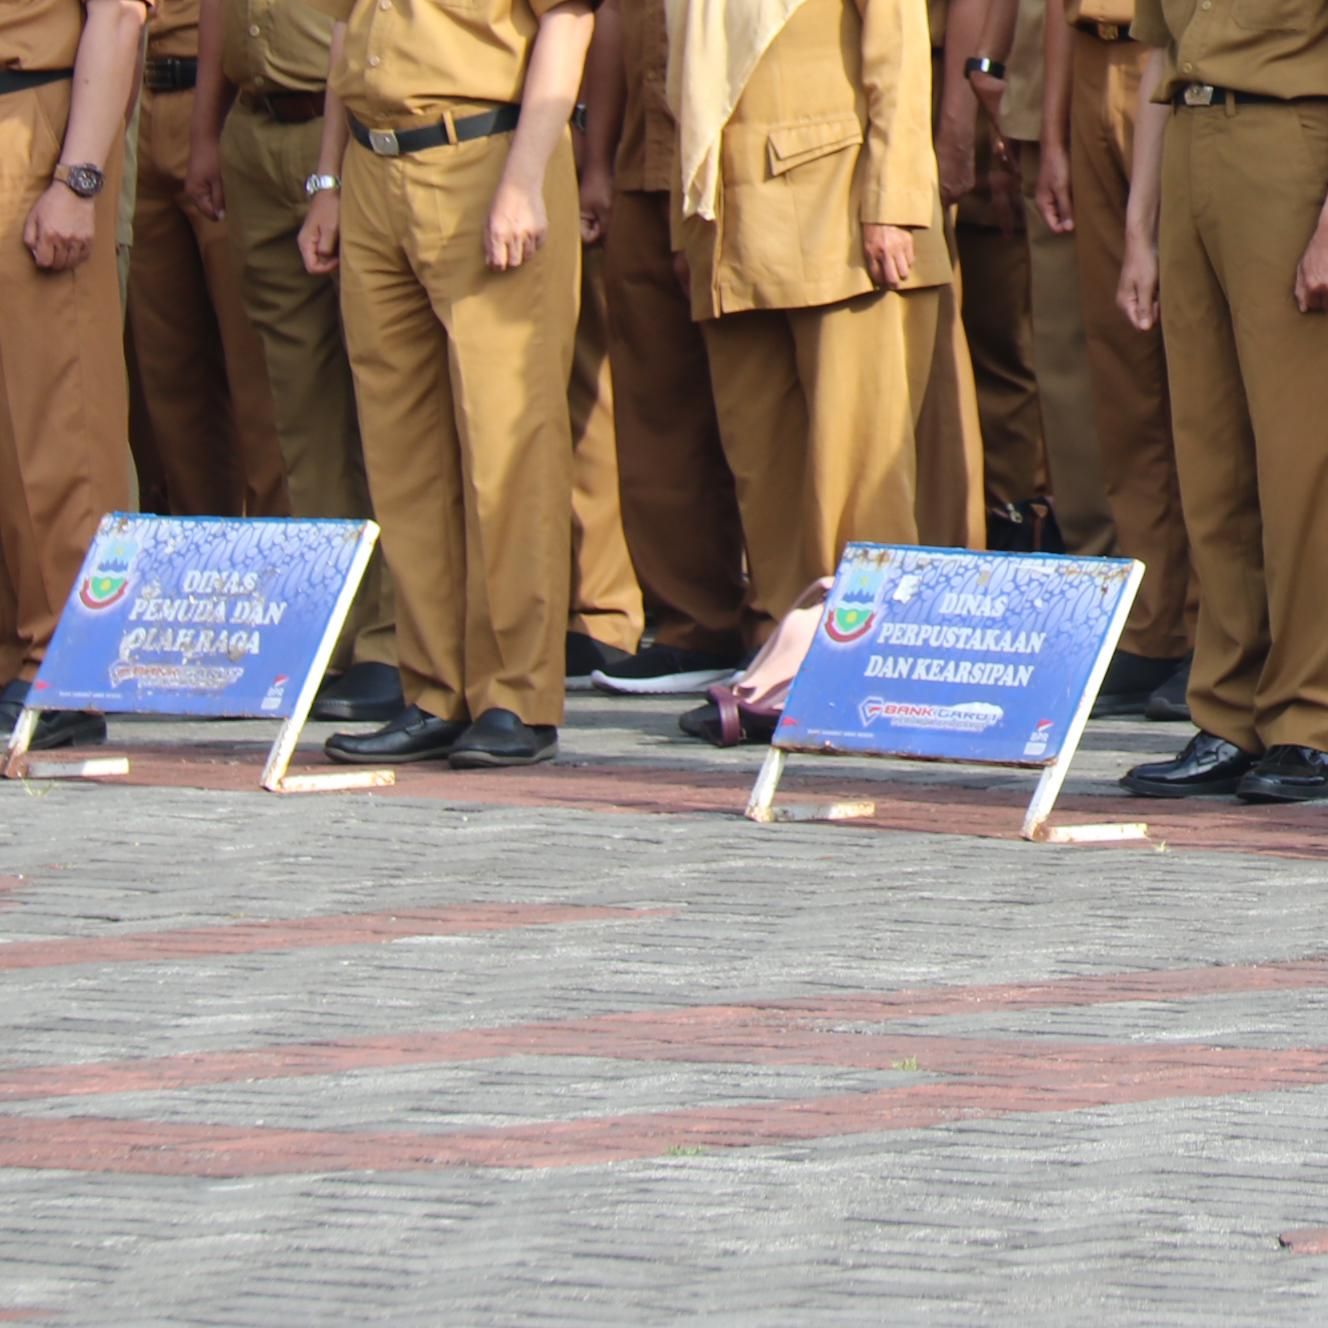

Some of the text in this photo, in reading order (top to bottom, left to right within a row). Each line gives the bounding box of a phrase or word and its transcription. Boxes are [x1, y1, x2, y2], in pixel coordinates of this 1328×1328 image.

[184, 570, 258, 594] DINAS
[129, 598, 288, 626] PEMUDA DAN
[938, 592, 1008, 617] DINAS
[876, 623, 1047, 654] PERPUSTAKAAN
[864, 655, 1035, 687] DAN KEARSIPAN
[884, 704, 933, 717] BANK
